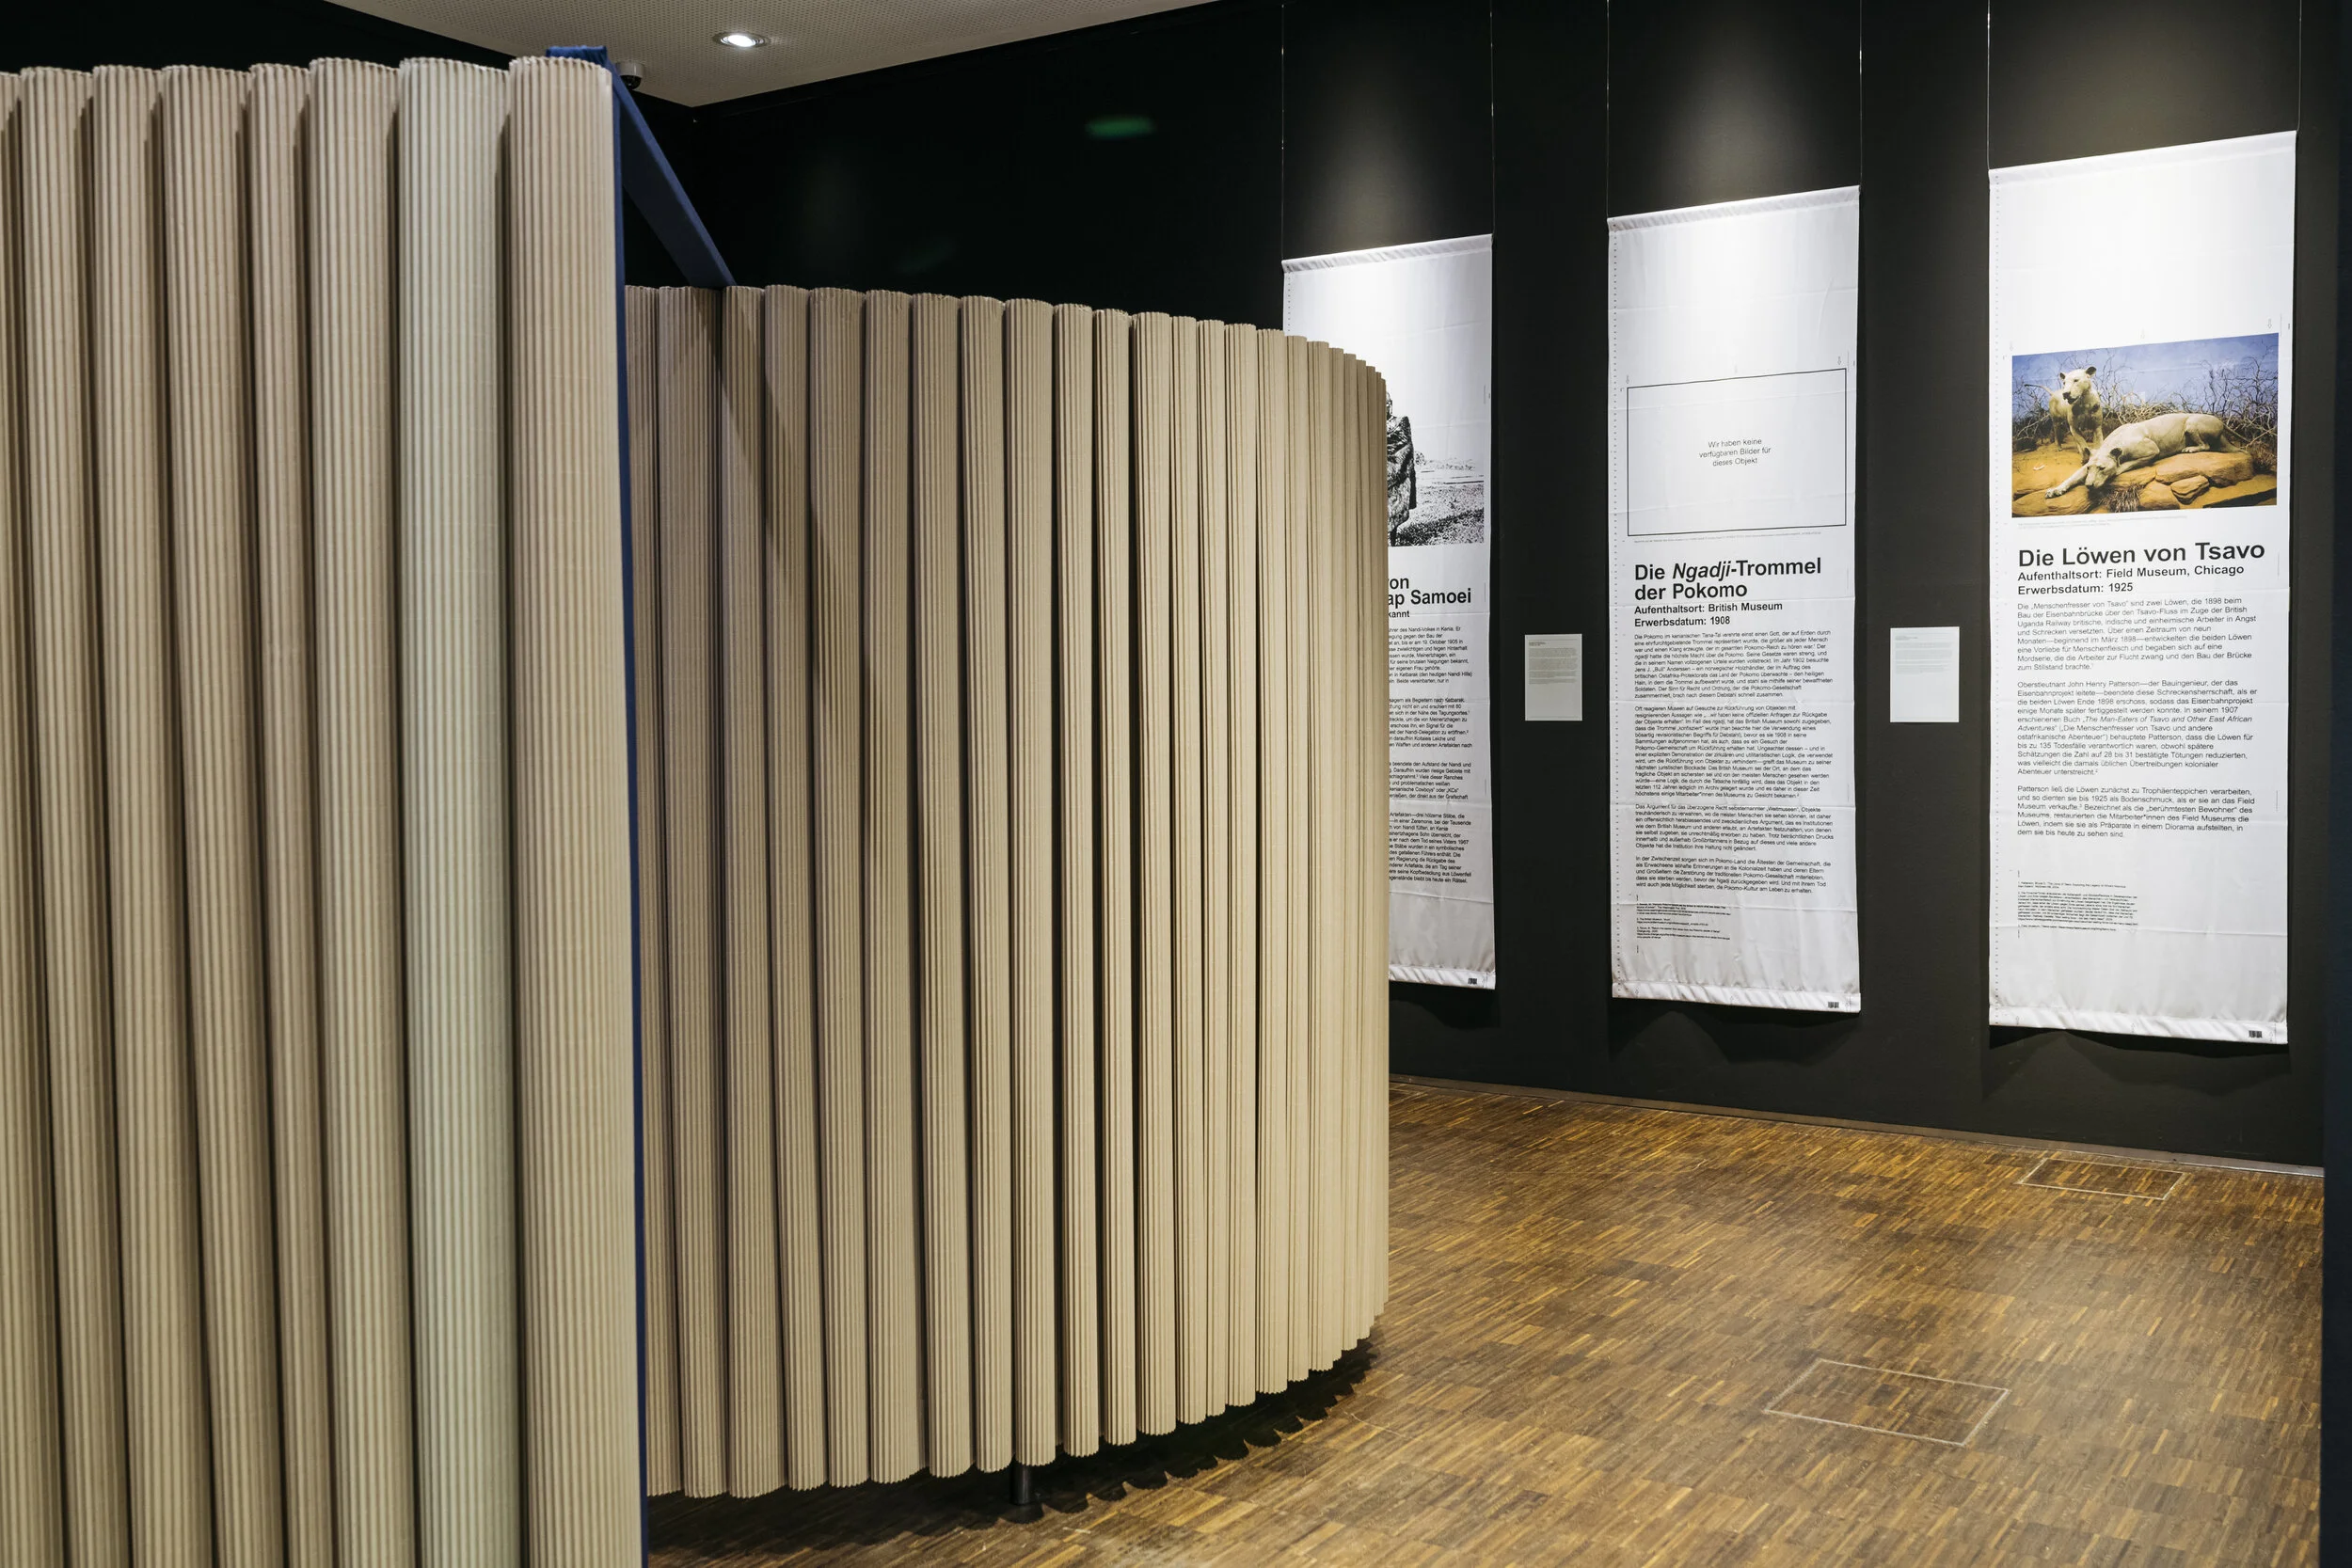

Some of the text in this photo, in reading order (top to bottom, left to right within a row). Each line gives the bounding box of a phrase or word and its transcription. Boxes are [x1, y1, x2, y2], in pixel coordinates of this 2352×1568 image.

[2019, 542, 2265, 567] Die Löwen von Tsavo
[1635, 558, 1821, 582] Die Ngadji-Trommel
[2018, 565, 2244, 580] Aufenthaltsort: Field Museum, Chicago
[1389, 577, 1409, 589] on
[2018, 583, 2133, 595] Erwerbsdatum: 1925
[1411, 588, 1471, 604] Samoei
[1635, 583, 1747, 600] der Pokomo
[1634, 602, 1782, 614] Aufenthaltsort: British Museum
[2045, 609, 2103, 617] Eisenbahnbrücke
[2190, 607, 2209, 616] Zuge
[1635, 616, 1730, 627] Erwerbsdatum: 1908
[2017, 620, 2044, 629] Uganda
[2045, 619, 2071, 628] Railway
[2235, 615, 2256, 624] Angst
[2107, 625, 2124, 634] Über
[2145, 644, 2176, 653] begaben
[2187, 742, 2214, 751] spätere
[2018, 751, 2061, 759] Schätzungen
[2135, 751, 2169, 760] bestätigte
[2172, 751, 2203, 760] Tötungen
[2142, 786, 2208, 796] Trophäenteppichen
